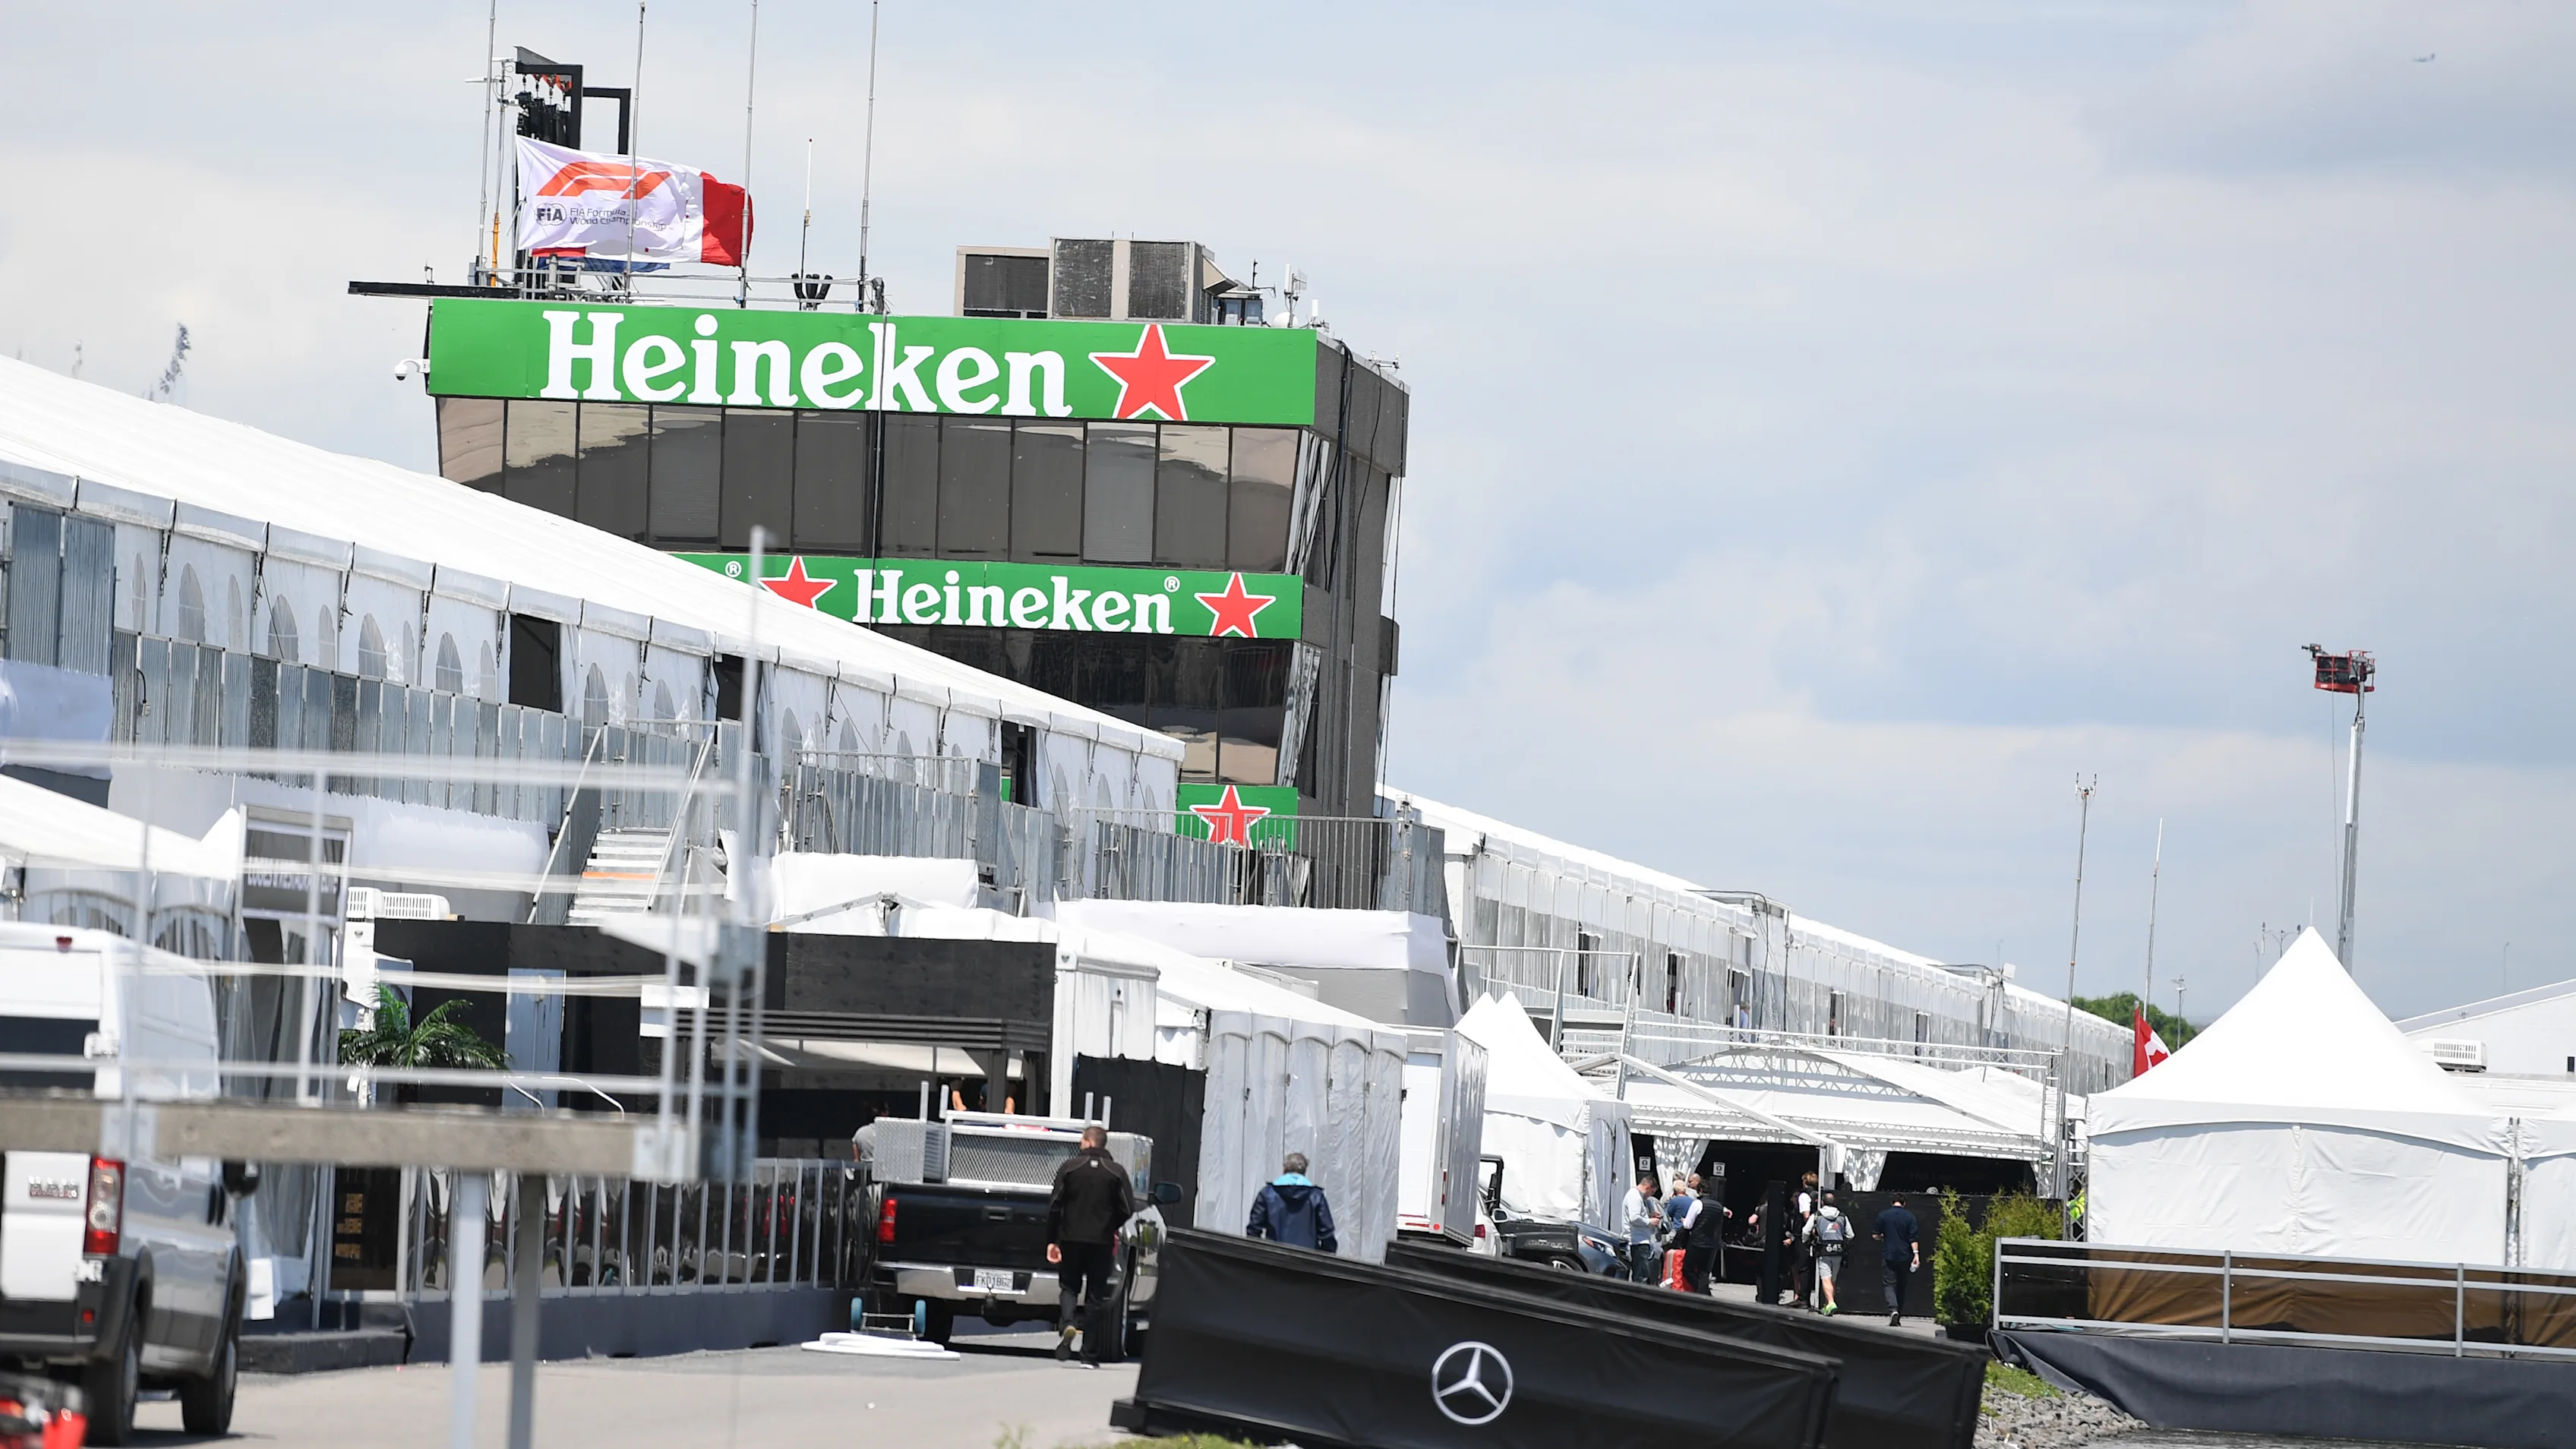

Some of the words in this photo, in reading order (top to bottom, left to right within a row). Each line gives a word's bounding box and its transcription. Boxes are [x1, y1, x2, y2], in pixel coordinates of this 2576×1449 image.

[587, 209, 626, 217] Formula
[539, 310, 1073, 417] Heineken
[1826, 1244, 1843, 1252] 645
